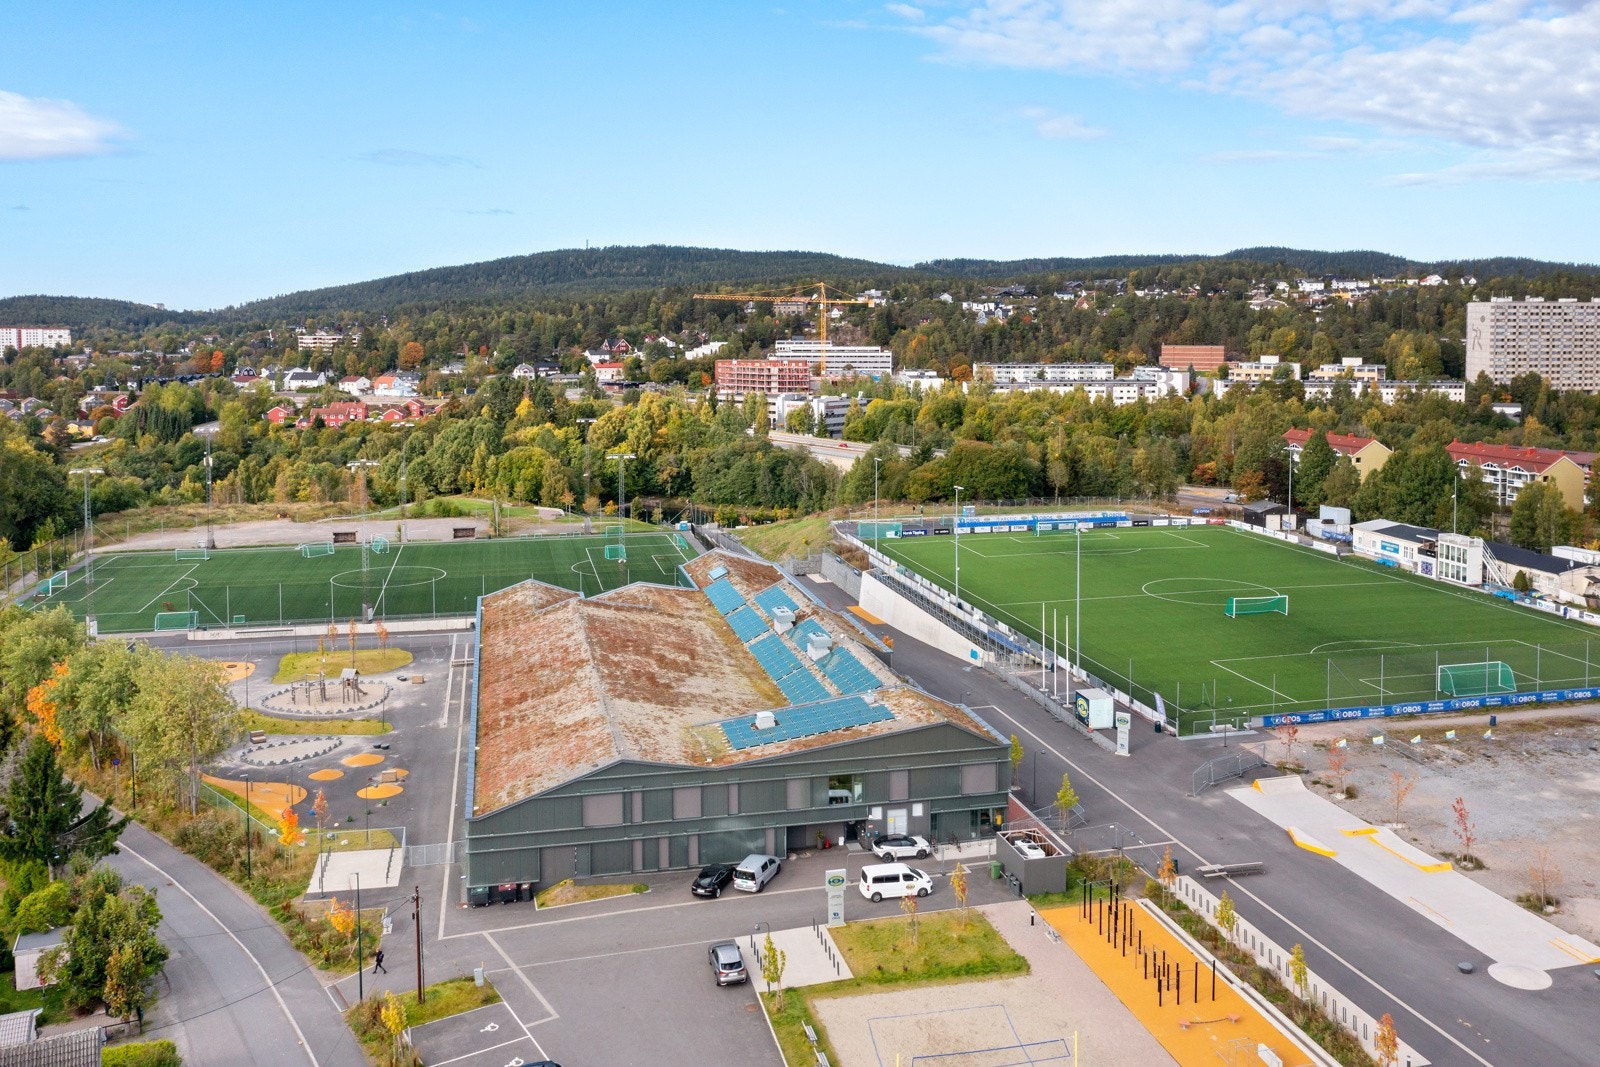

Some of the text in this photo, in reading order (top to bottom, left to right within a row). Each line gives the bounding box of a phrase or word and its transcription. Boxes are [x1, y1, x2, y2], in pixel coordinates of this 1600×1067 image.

[1518, 695, 1536, 703] OBOS
[1461, 700, 1480, 708] OBOS
[1342, 710, 1362, 718] OBOS
[1281, 715, 1301, 724] OOS
